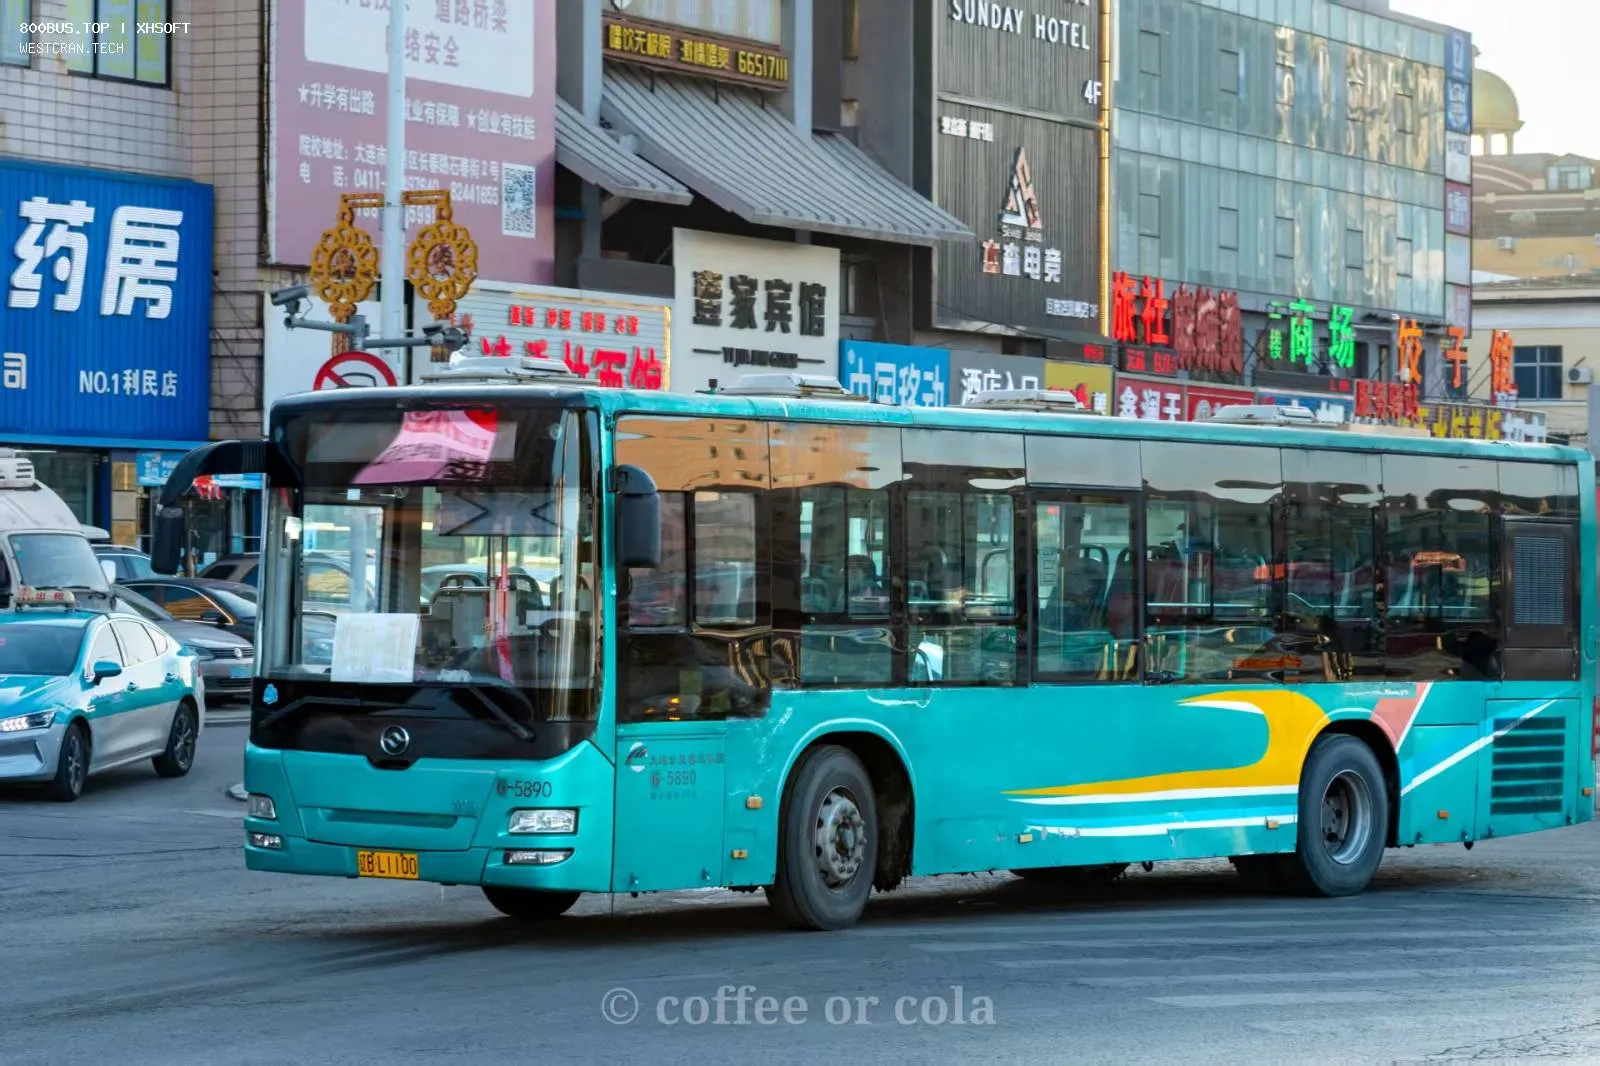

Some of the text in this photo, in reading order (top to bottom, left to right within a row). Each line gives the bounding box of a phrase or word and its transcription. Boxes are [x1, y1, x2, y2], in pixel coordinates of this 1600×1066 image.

[385, 25, 461, 67] 络安全
[951, 0, 1091, 50] SUNDAY HOTEL
[1083, 79, 1102, 105] 4F
[7, 196, 185, 320] 药房
[1112, 271, 1169, 346] 旅社
[1289, 298, 1355, 369] 商场
[3, 352, 28, 390] 司
[79, 368, 179, 397] NO.1利民店
[497, 778, 552, 800] -5890
